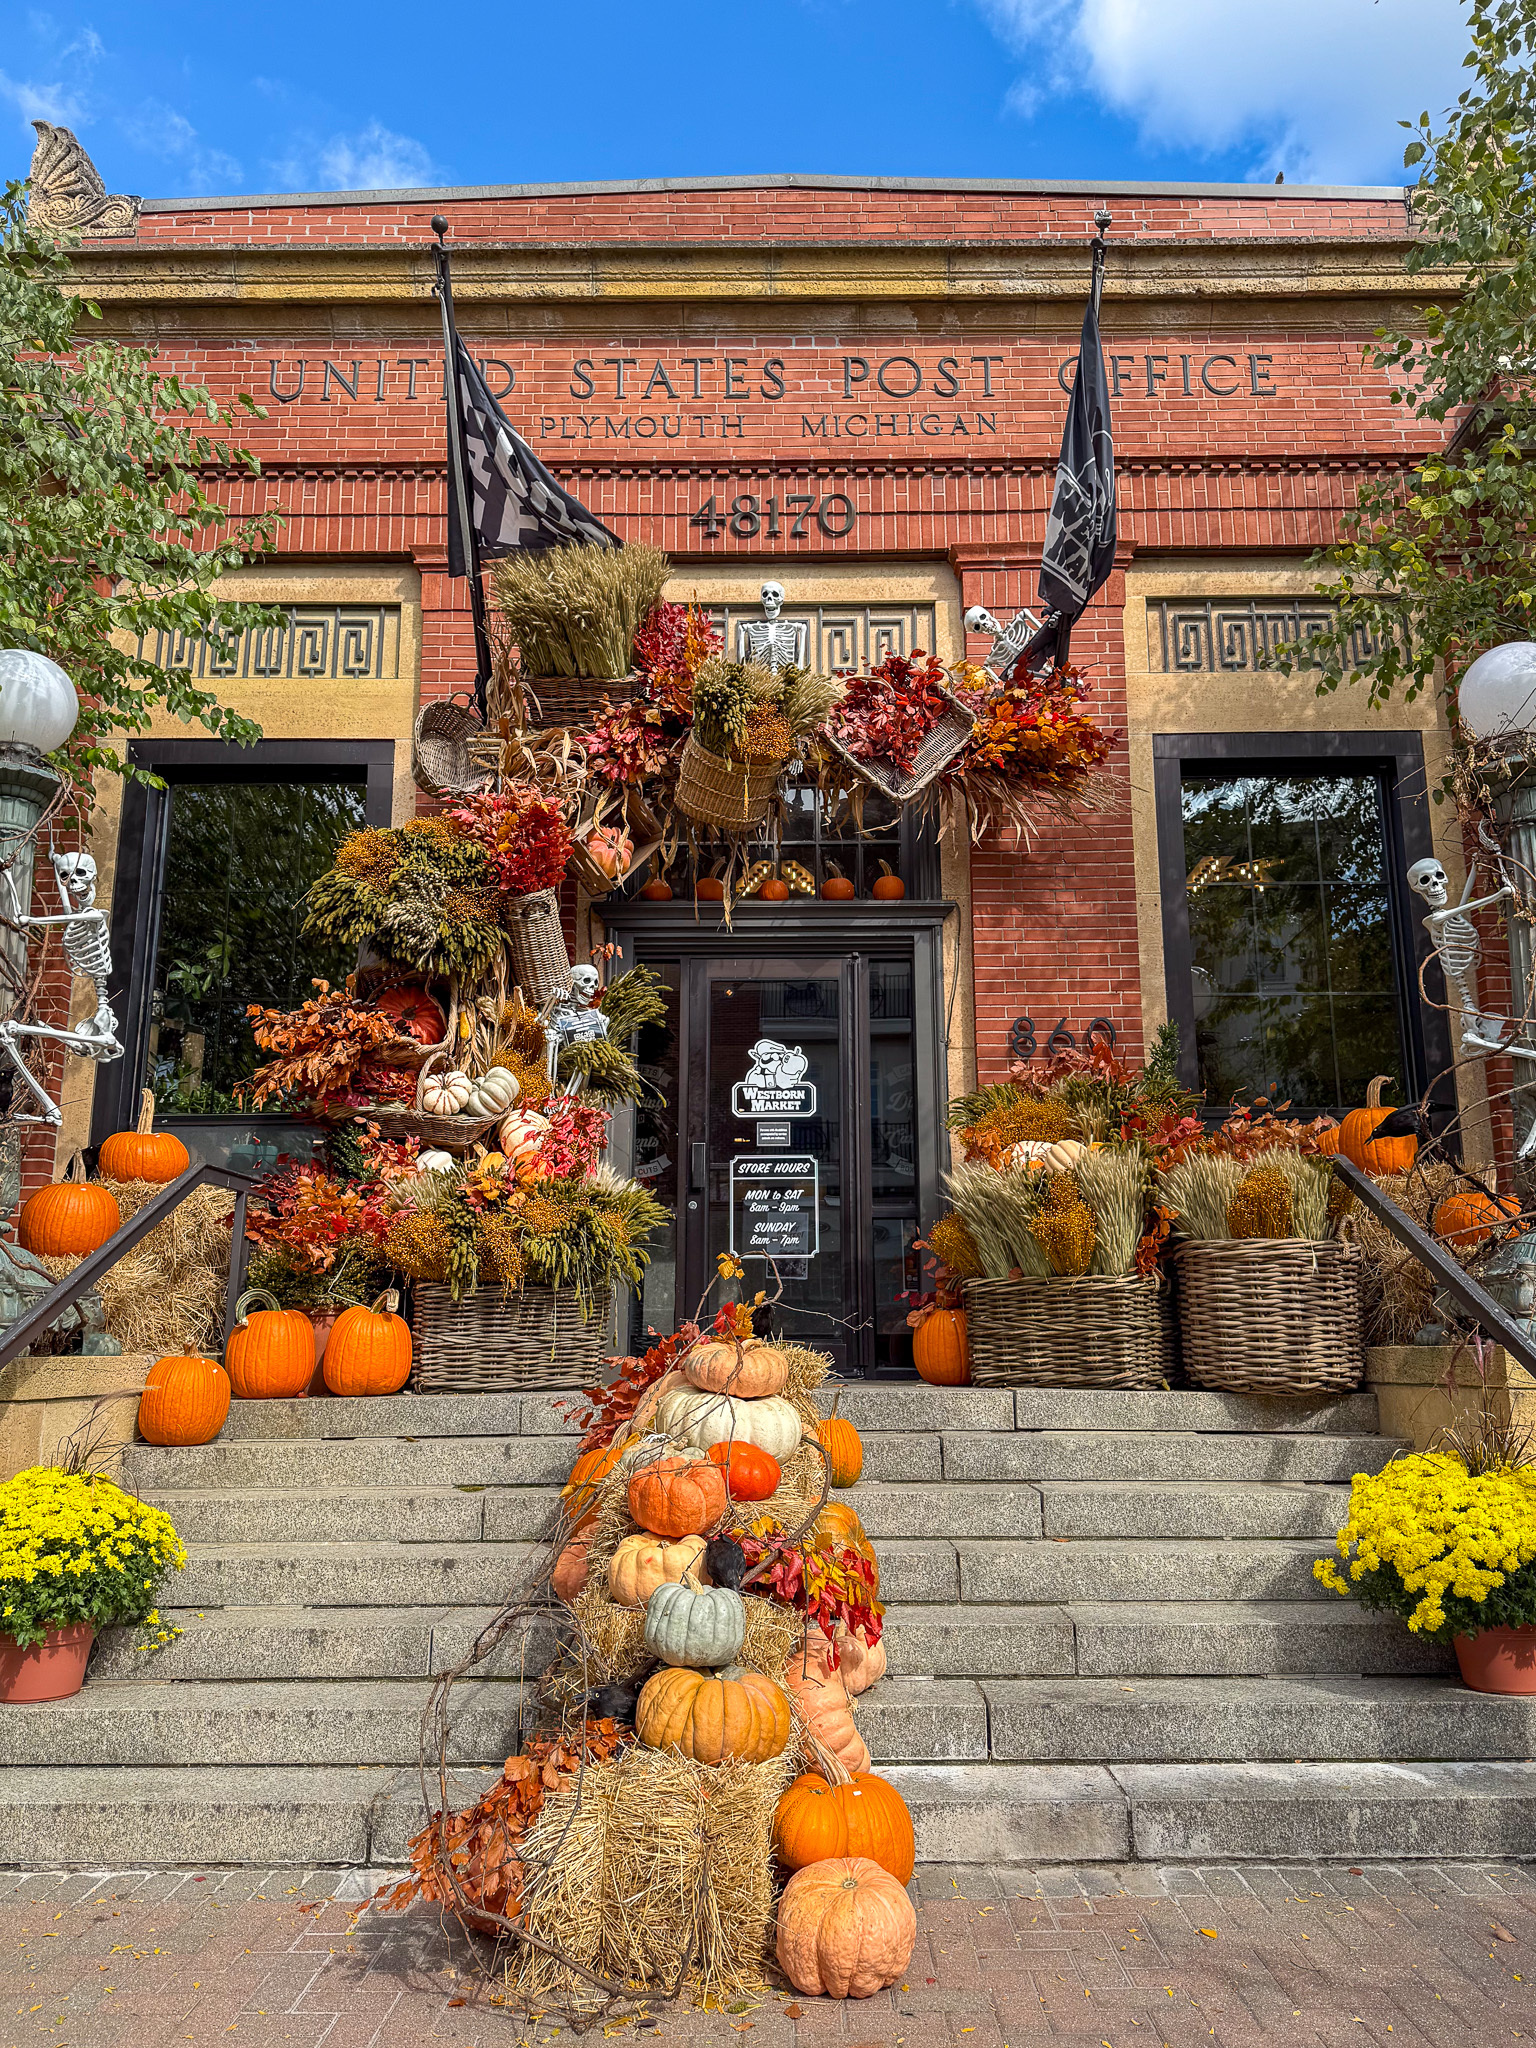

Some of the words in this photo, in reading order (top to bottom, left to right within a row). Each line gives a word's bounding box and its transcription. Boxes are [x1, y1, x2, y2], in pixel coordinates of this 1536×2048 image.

[269, 358, 516, 402] UNITD
[569, 357, 787, 401] STATES
[842, 355, 1004, 399] POST
[539, 414, 747, 439] PLYMOUTH
[801, 412, 999, 437] MICHIGAN
[690, 493, 857, 539] 48170
[1012, 1016, 1116, 1057] 860
[743, 1087, 805, 1100] WESTBORN
[751, 1100, 801, 1112] MARKET
[637, 1165, 659, 1176] CUTS
[738, 1163, 772, 1174] STORE
[774, 1162, 811, 1174] HOURS
[744, 1190, 770, 1200] MON
[772, 1190, 781, 1200] to
[783, 1189, 804, 1200] SAT
[750, 1202, 770, 1213] 8am
[779, 1202, 800, 1214] 9pm
[753, 1222, 797, 1233] SUNDAY
[750, 1235, 770, 1245] 8am
[780, 1235, 800, 1247] 7pm
